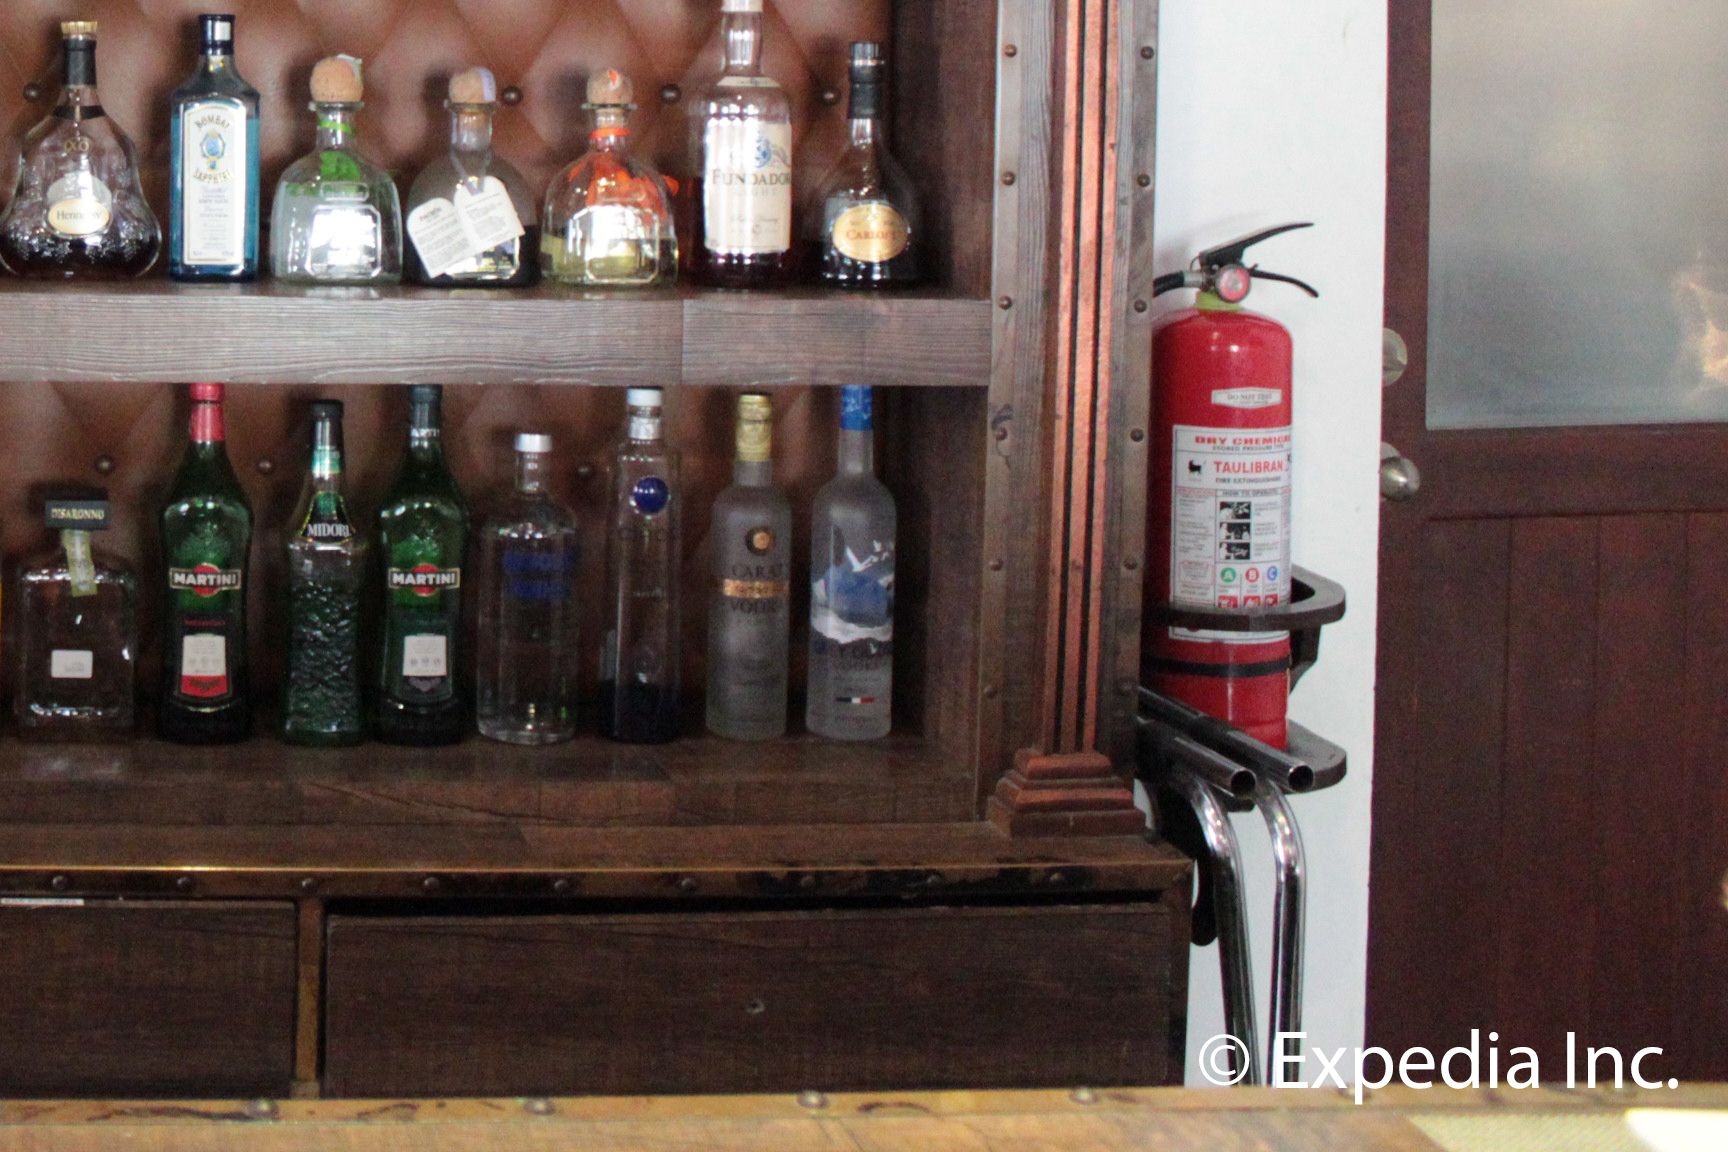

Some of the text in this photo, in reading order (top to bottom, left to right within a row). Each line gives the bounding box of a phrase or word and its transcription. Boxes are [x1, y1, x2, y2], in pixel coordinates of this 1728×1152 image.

[194, 114, 231, 129] BOMBAY
[51, 508, 105, 520] DISARONNO
[173, 573, 237, 586] MARTINI
[392, 572, 456, 586] MARTINI
